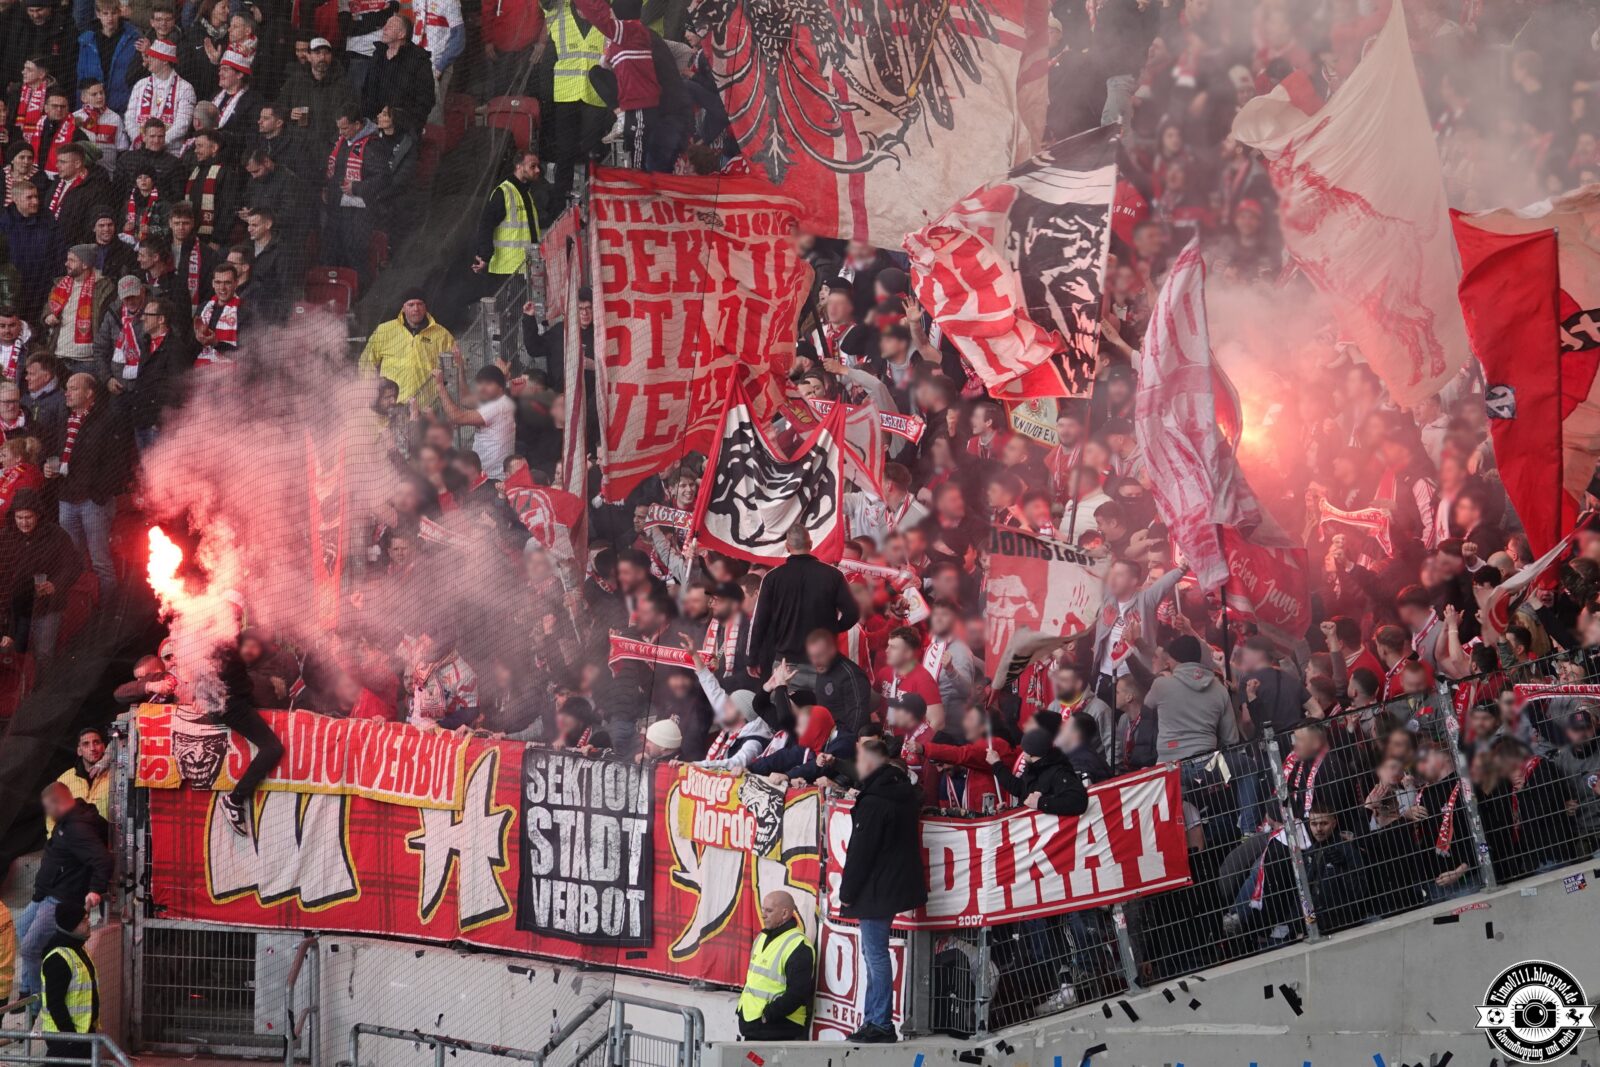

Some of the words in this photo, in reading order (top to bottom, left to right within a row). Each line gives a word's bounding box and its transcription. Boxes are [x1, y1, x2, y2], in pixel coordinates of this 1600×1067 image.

[597, 229, 806, 300] SEKTIO
[228, 709, 463, 802] SADIONVERBOT
[526, 752, 650, 815] SEKTION
[680, 764, 733, 803] Junge
[526, 806, 648, 886] STADT
[693, 806, 756, 850] Horde
[531, 878, 646, 938] VERBOT
[957, 914, 984, 928] 2007
